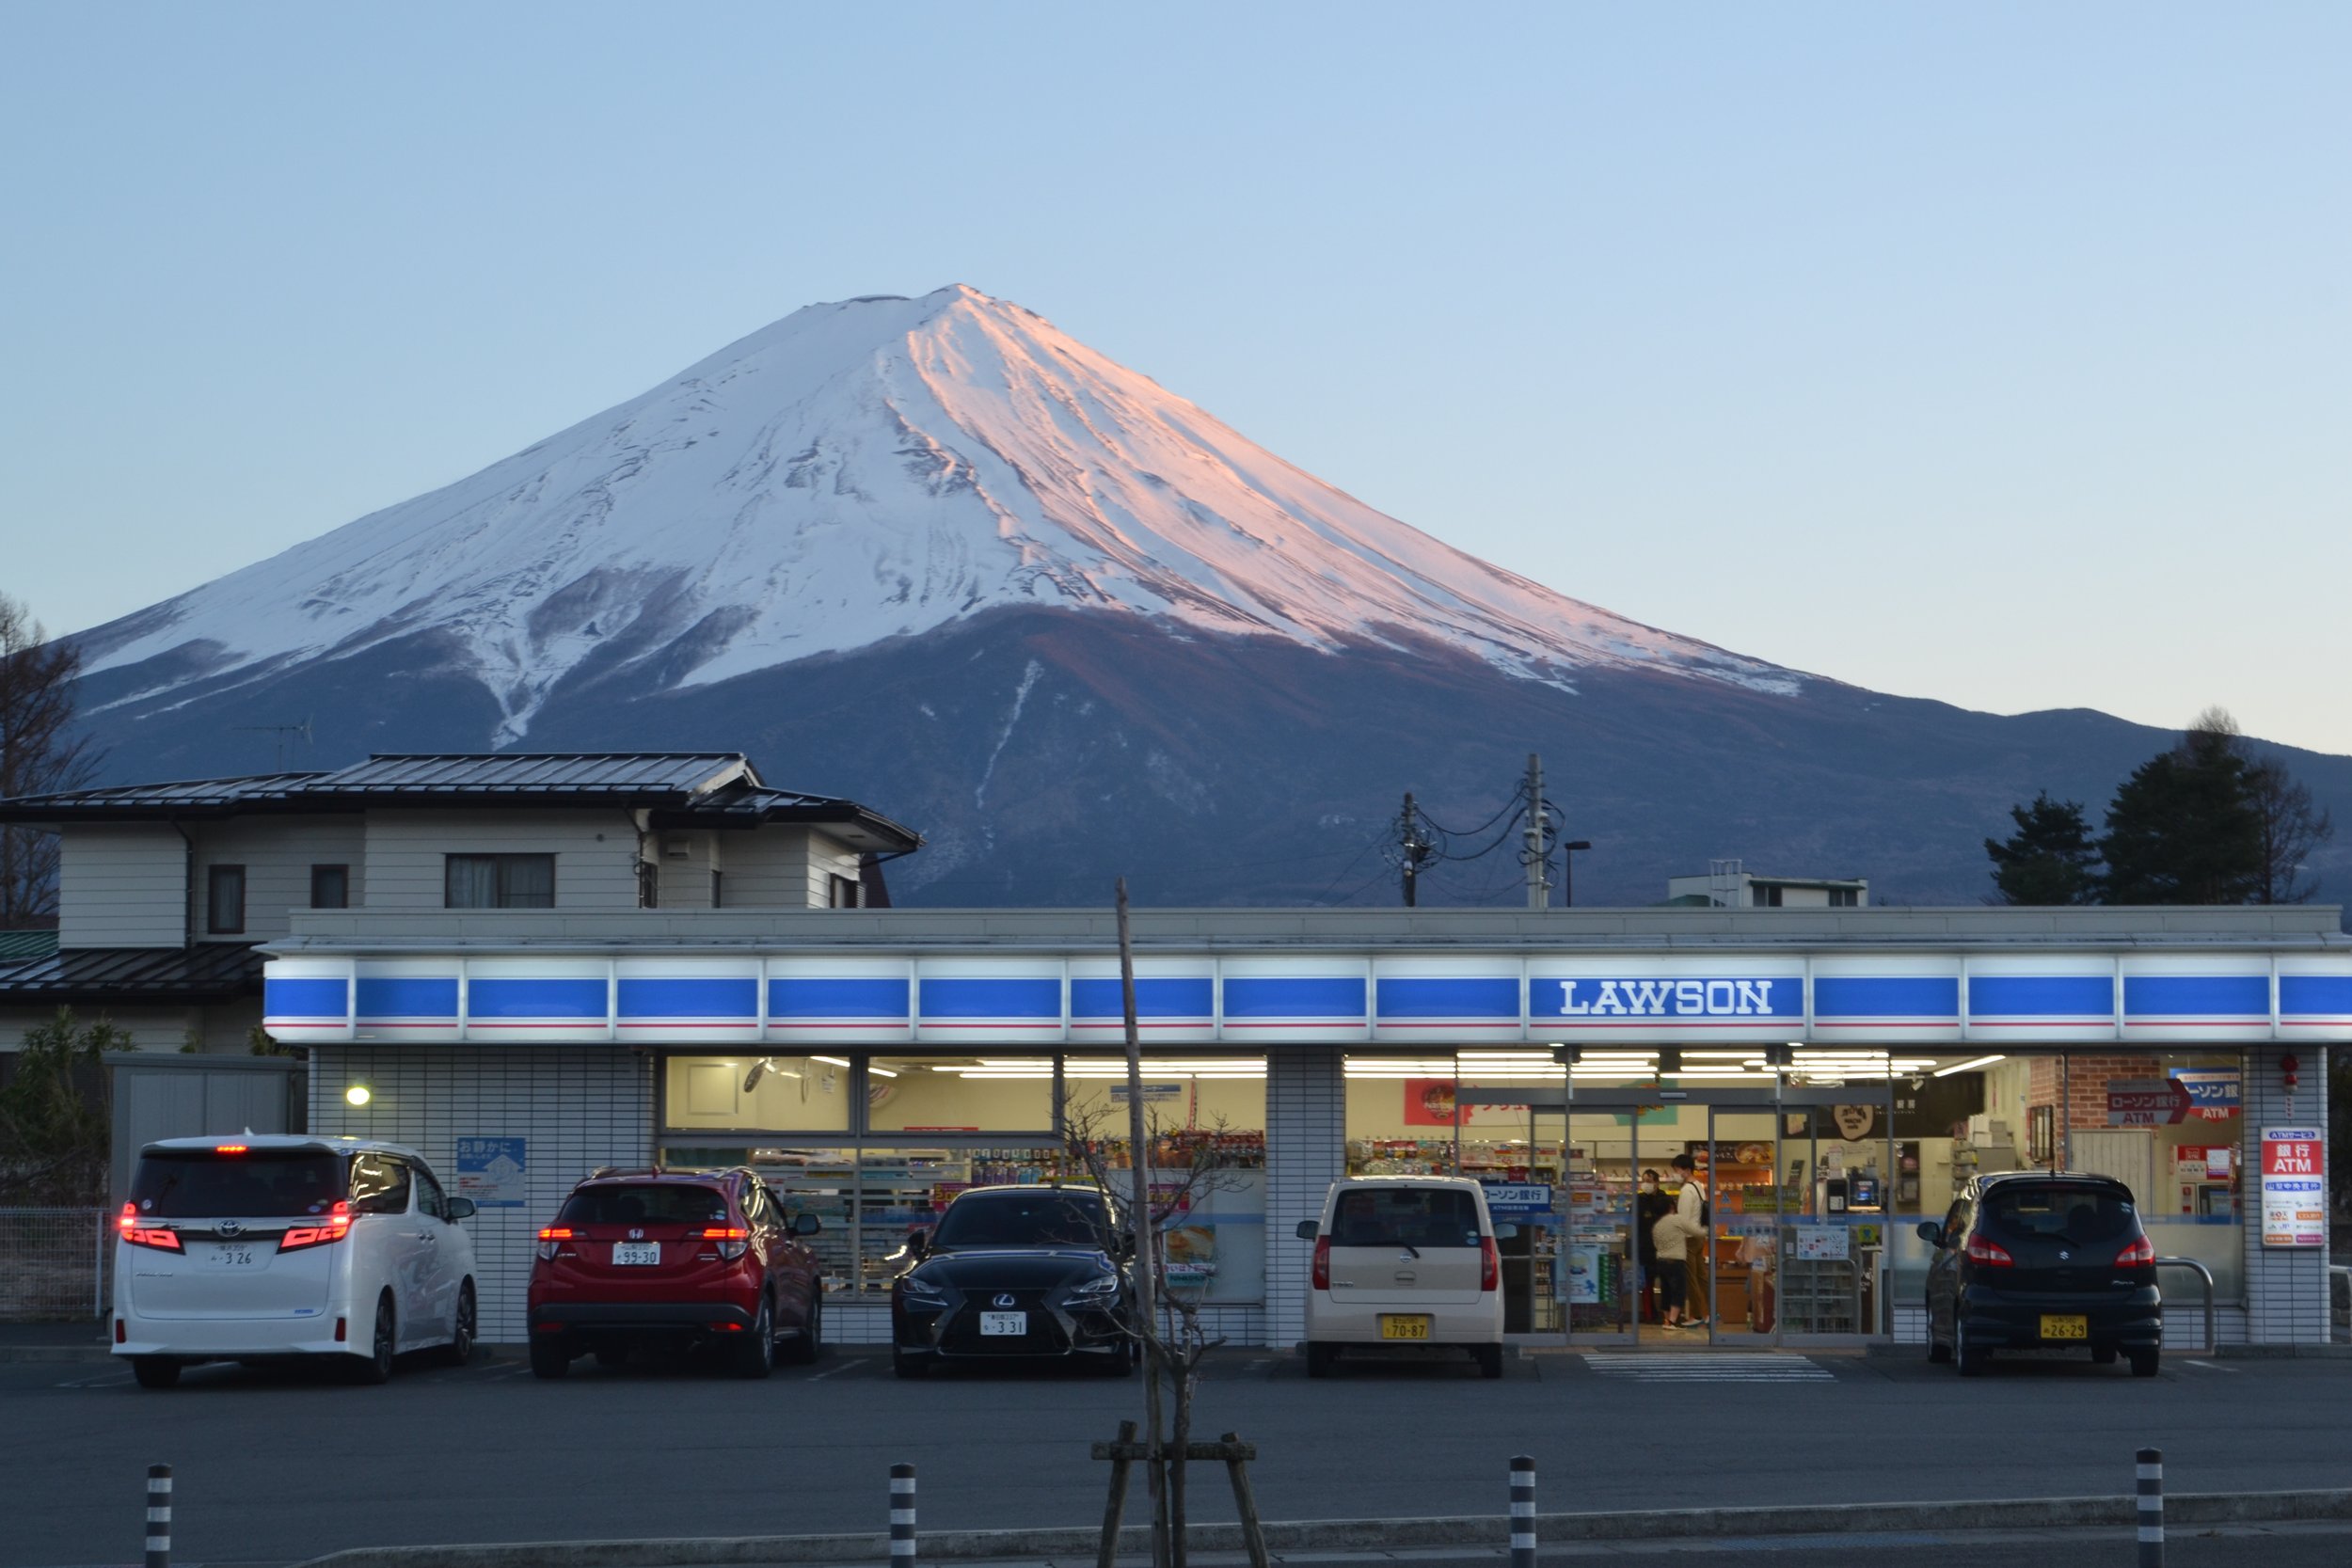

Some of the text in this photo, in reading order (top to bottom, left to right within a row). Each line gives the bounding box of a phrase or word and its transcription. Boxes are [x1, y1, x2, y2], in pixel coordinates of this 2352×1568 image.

[1559, 980, 1773, 1016] LAWSON
[2185, 1085, 2239, 1099] ーソン銀
[2112, 1095, 2181, 1108] ローソン銀行
[2122, 1112, 2155, 1124] ATM
[2201, 1107, 2229, 1119] ATM
[459, 1140, 512, 1153] お静かに
[2277, 1144, 2311, 1158] 銀行
[2273, 1158, 2312, 1173] ATM
[624, 1251, 657, 1263] 99-30
[1391, 1324, 1426, 1338] 70-87
[2050, 1323, 2086, 1337] 26-29
